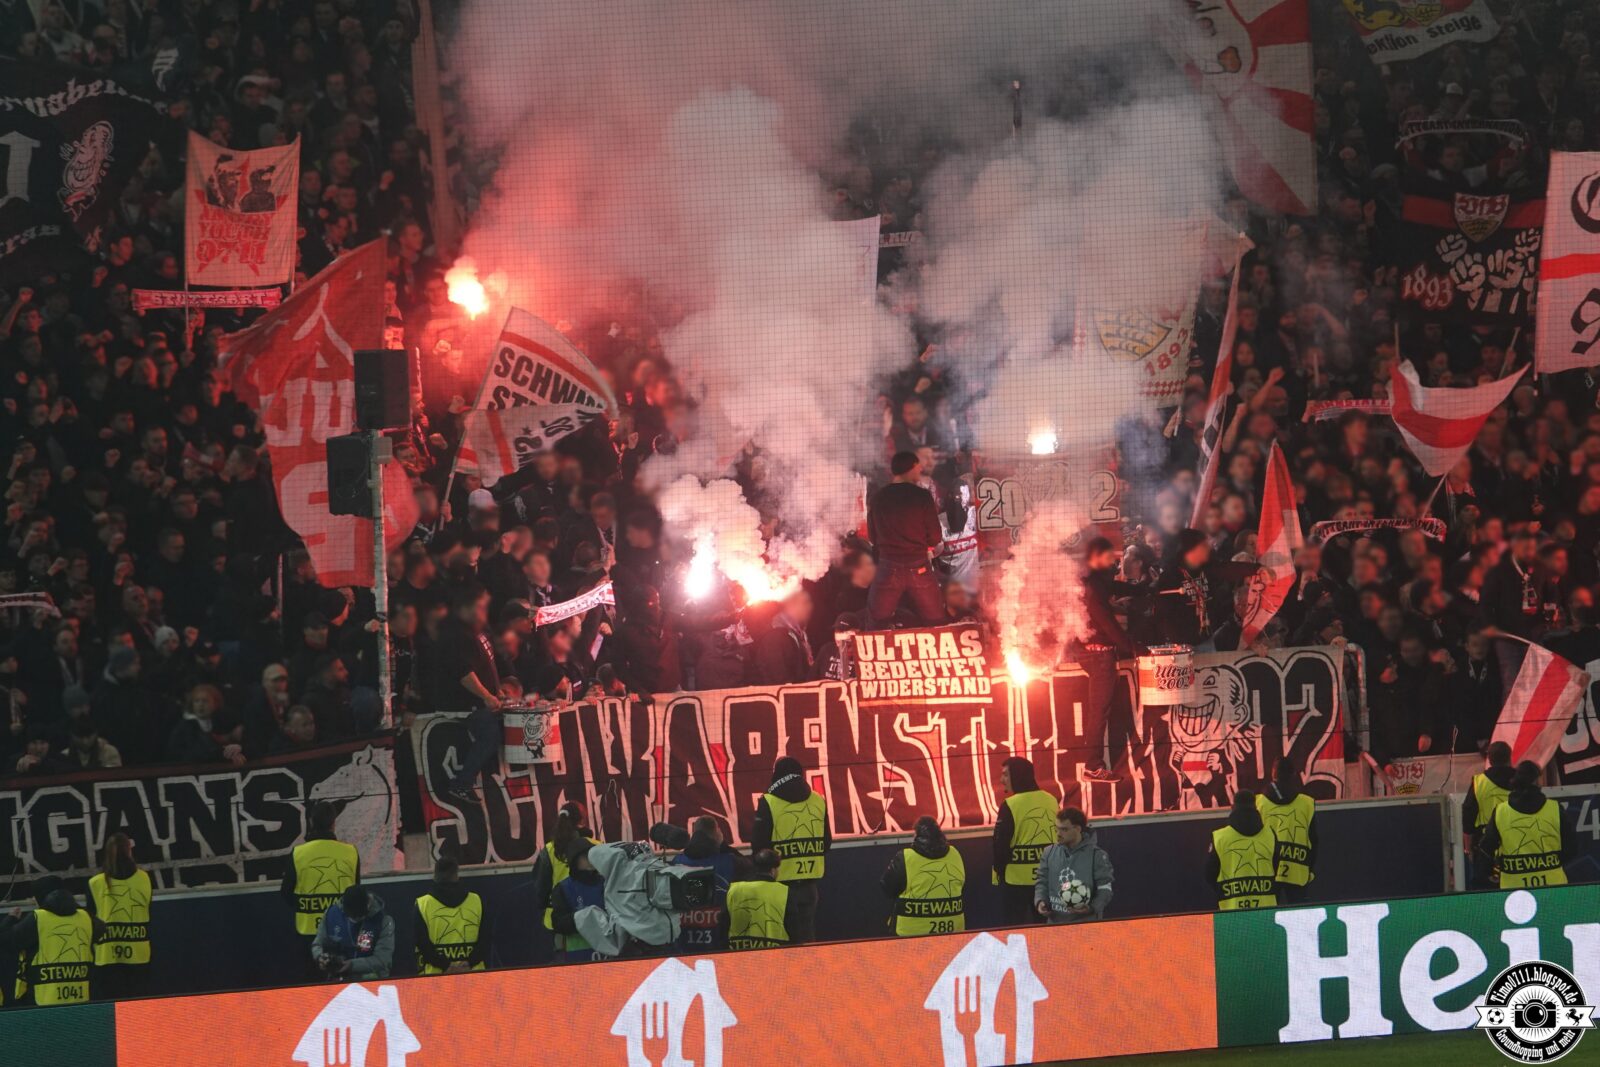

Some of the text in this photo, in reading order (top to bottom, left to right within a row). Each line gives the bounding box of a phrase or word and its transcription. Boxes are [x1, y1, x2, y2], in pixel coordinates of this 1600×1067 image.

[1402, 262, 1454, 310] 1893
[1144, 327, 1189, 378] 1893
[855, 630, 983, 661] ULTRAS
[858, 656, 986, 681] BEDEUTET
[860, 677, 991, 699] WIDERSTAND
[904, 900, 963, 915] STEWARD
[687, 929, 713, 944] 123
[929, 920, 955, 934] 288
[56, 984, 84, 1001] 1041
